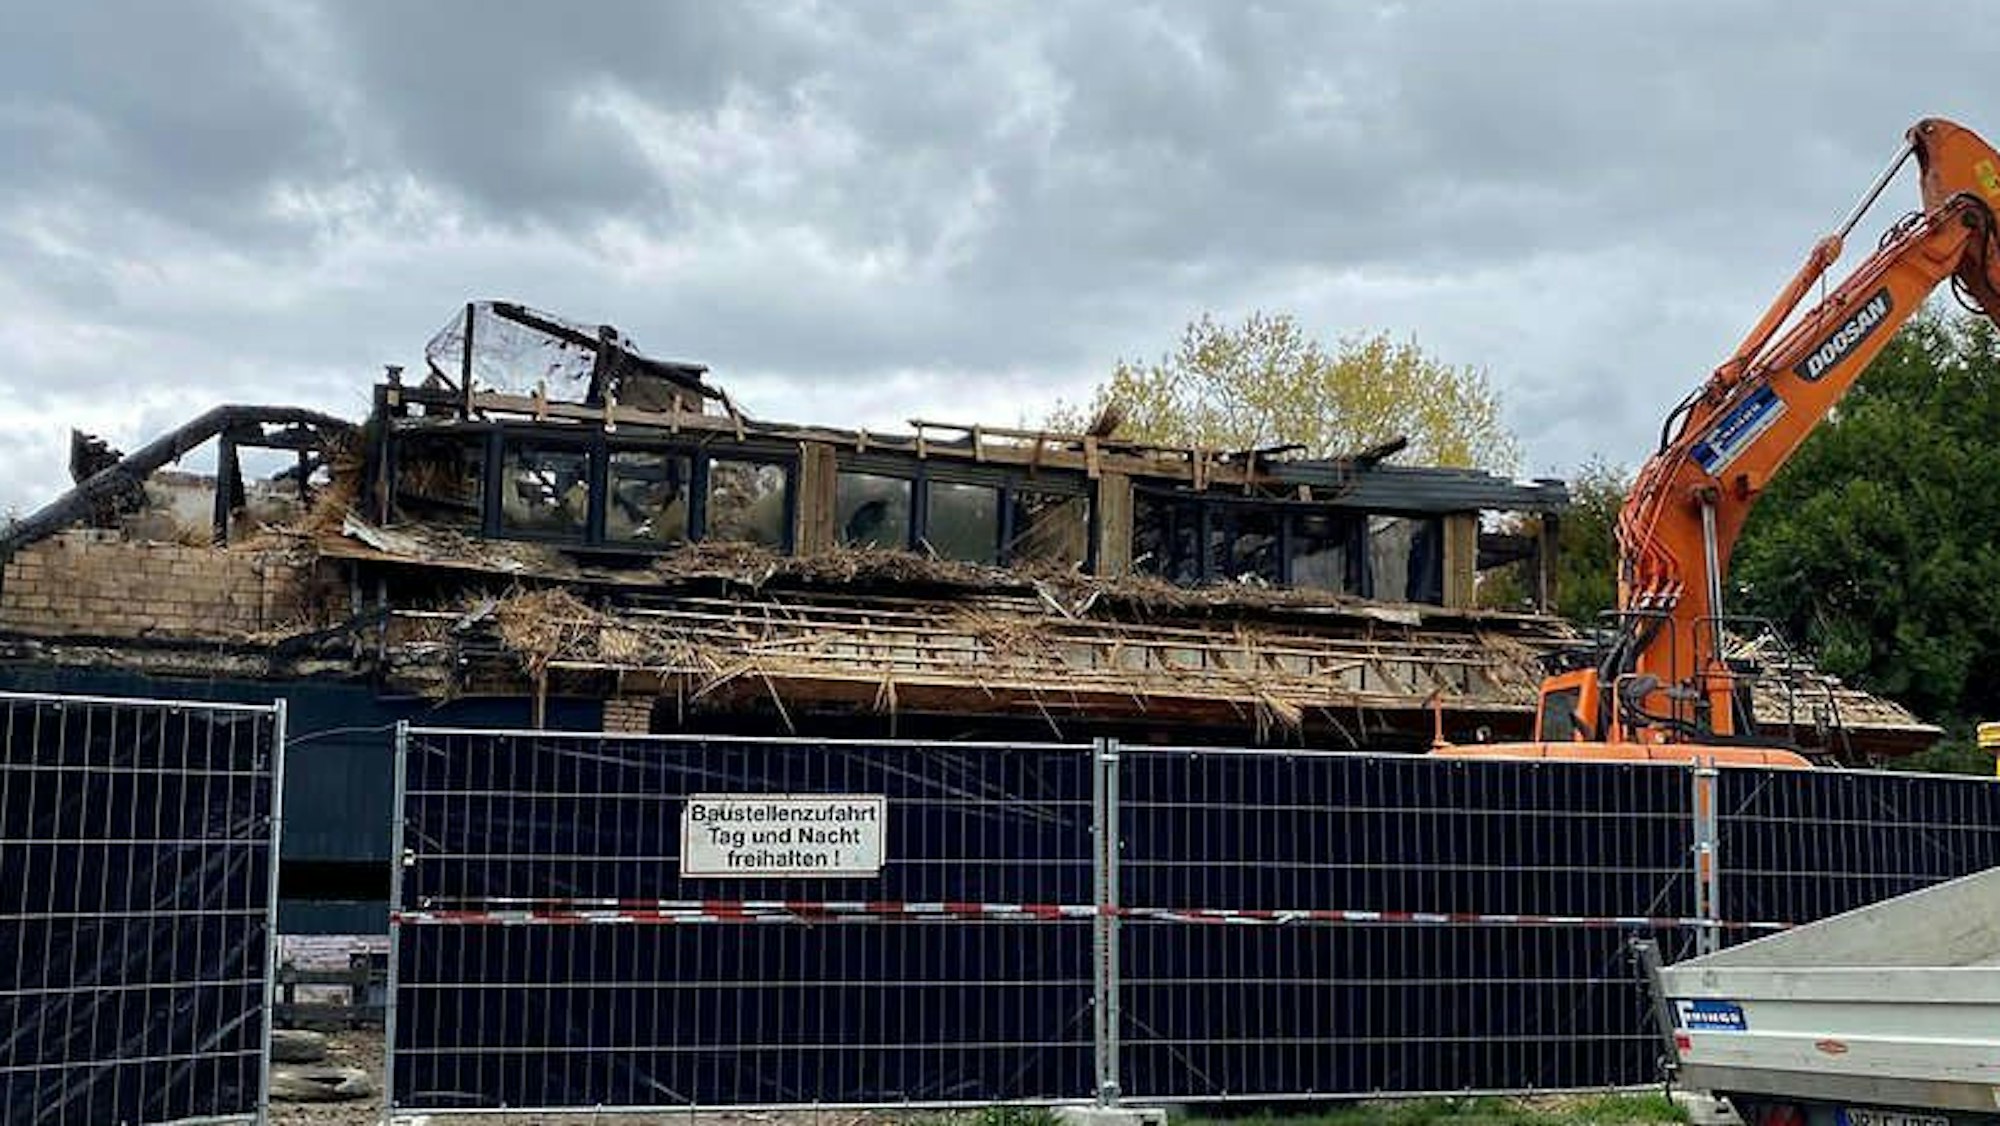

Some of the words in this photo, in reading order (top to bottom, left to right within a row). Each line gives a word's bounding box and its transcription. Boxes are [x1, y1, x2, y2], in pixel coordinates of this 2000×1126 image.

[1807, 296, 1888, 379] DOOSAN
[691, 804, 875, 822] Baustellenzufahrt
[707, 827, 745, 848] Tag
[752, 828, 791, 844] und
[799, 827, 861, 844] Nacht
[728, 850, 827, 867] freihalten
